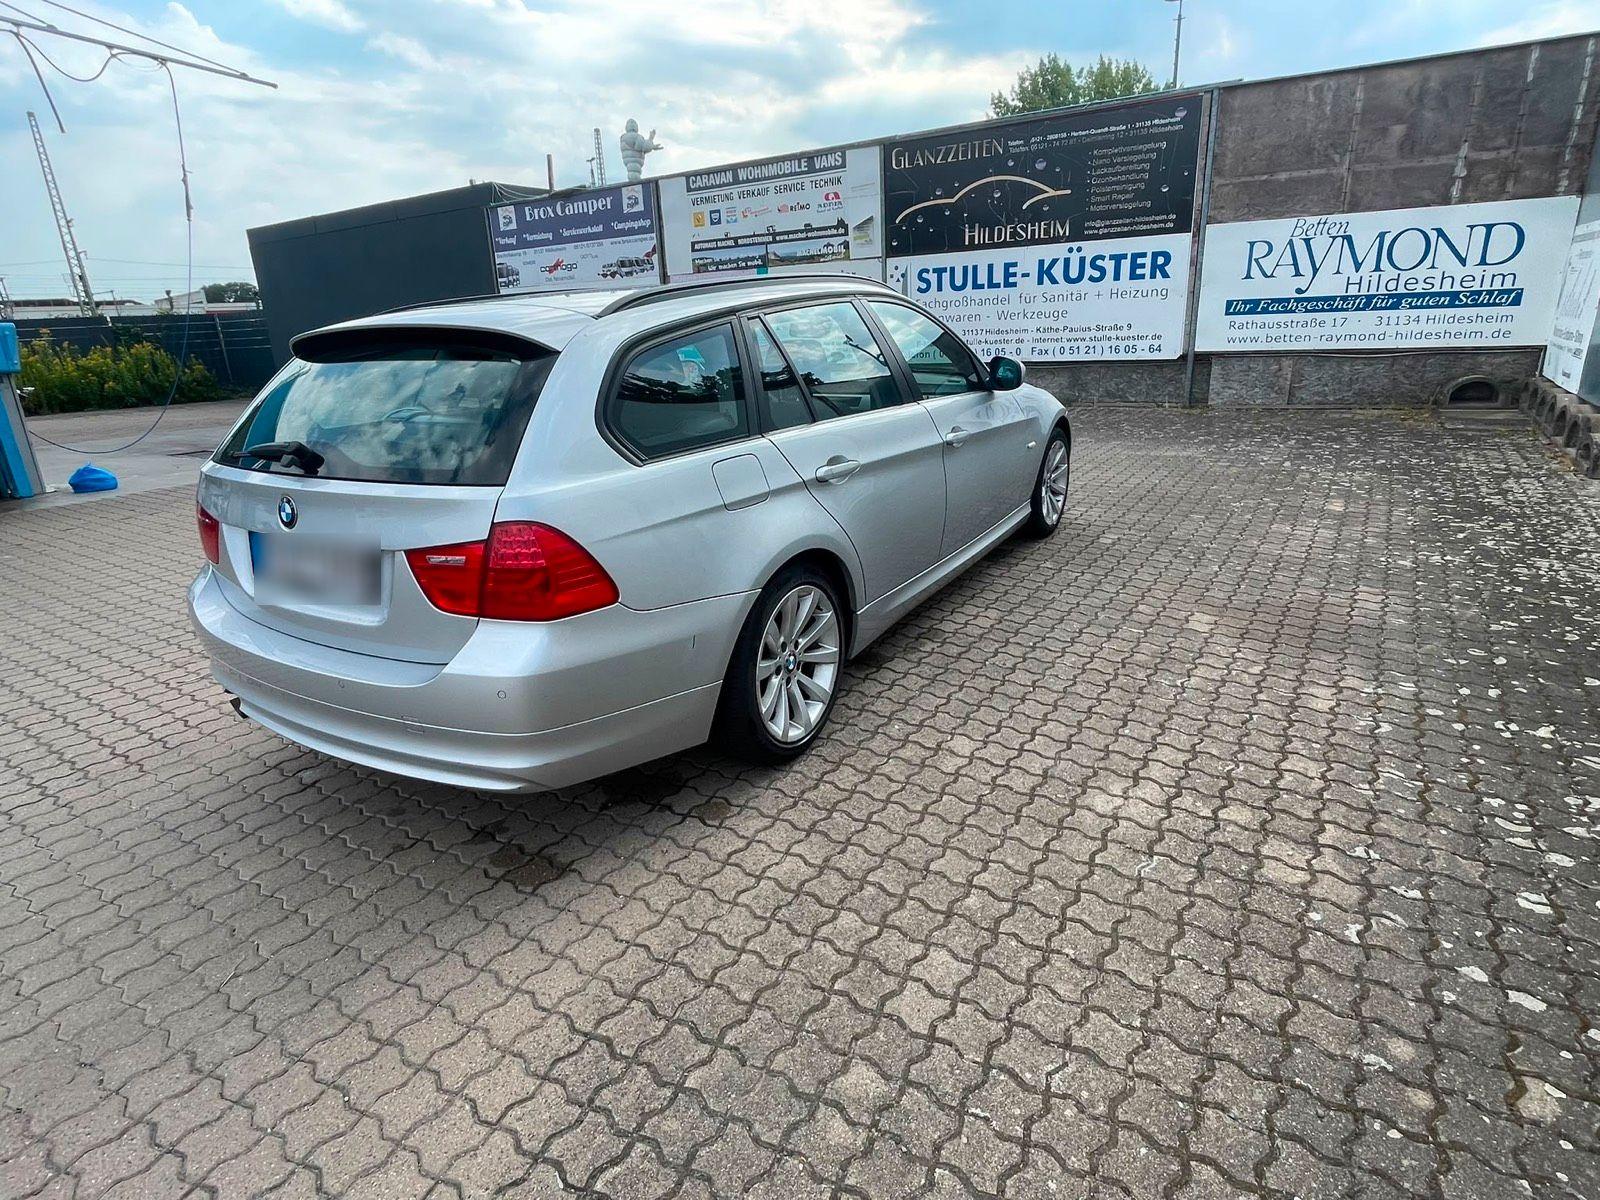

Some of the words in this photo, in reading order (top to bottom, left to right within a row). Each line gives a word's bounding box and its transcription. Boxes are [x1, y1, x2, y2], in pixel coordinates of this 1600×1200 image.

[891, 138, 1004, 170] GLANZZEITEN
[689, 169, 733, 189] CARAVAN
[737, 158, 808, 181] WOHNMOBILE
[813, 151, 842, 169] VANS
[1091, 162, 1150, 175] Lackaufbereitung
[1091, 172, 1149, 184] Ozonbehandlung
[691, 192, 734, 206] VERMIETUNG
[737, 187, 770, 200] VERKAUF
[773, 182, 806, 194] SERVICE
[810, 176, 843, 189] TECHNIK
[1090, 194, 1111, 203] Smart
[1111, 192, 1135, 201] Repair
[524, 206, 555, 221] Brox
[556, 196, 613, 217] Camper
[964, 219, 1070, 246] HILDESHEIM
[1290, 217, 1350, 238] Betten
[1241, 221, 1526, 295] RAYMOND
[916, 245, 1172, 294] STULLE-KÜSTER
[1345, 269, 1517, 294] Hildesheim
[1019, 292, 1037, 304] für
[1041, 290, 1089, 303] Sanitär
[1094, 290, 1104, 300] +
[1110, 287, 1169, 300] Heizung
[1228, 300, 1254, 313] Ihr
[1256, 296, 1367, 313] Fachgeschäft
[1365, 295, 1397, 311] für
[1398, 295, 1451, 310] guten
[1455, 290, 1521, 306] Schlaf
[938, 312, 981, 323] nwaren
[996, 309, 1068, 321] Werkzeuge
[1228, 317, 1327, 330] Rathausstraße
[1331, 317, 1348, 328] 17
[1374, 315, 1421, 327] 31134
[1425, 312, 1515, 325] Hildesheim
[962, 328, 984, 336] 31137
[985, 327, 1029, 335] Hildesheim
[1036, 323, 1124, 334] Käthe-Paulus-Straße
[1126, 323, 1132, 331] 9
[1226, 328, 1513, 344] www.betten-raymond-hildesheim.de
[965, 337, 1025, 346] tulle-kuester.de
[981, 347, 992, 357] 16
[994, 347, 1006, 356] 05
[1015, 347, 1022, 356] 0
[1031, 346, 1049, 356] Fax
[1059, 346, 1065, 355] 0
[1068, 345, 1080, 355] 51
[1084, 345, 1097, 355] 21
[1108, 345, 1121, 355] 16
[1124, 344, 1138, 354] 05
[1148, 343, 1162, 354] 64
